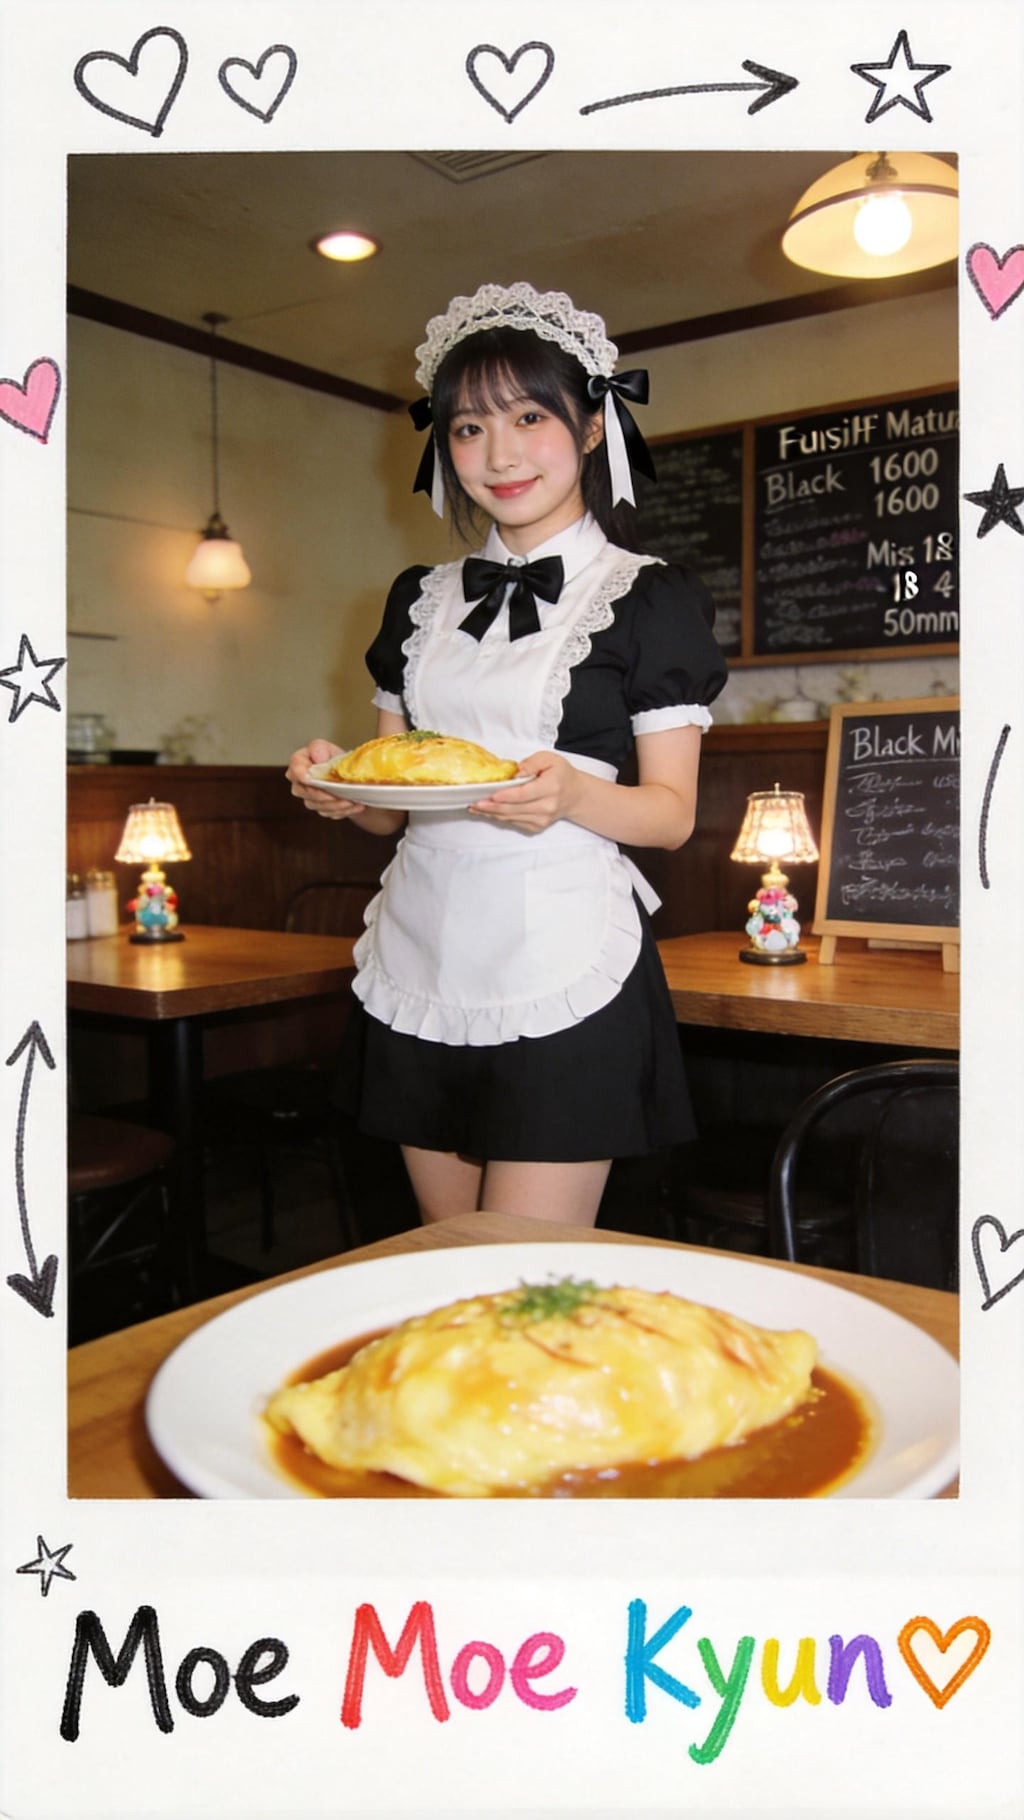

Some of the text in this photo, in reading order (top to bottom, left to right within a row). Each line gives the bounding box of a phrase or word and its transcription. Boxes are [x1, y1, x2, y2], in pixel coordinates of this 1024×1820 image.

[765, 448, 939, 505] Black 1600
[874, 484, 940, 518] 1600
[867, 540, 915, 569] Mis
[883, 608, 959, 636] 50mm
[849, 724, 926, 761] Black
[60, 1598, 892, 1765] Moe Moe Kyun
